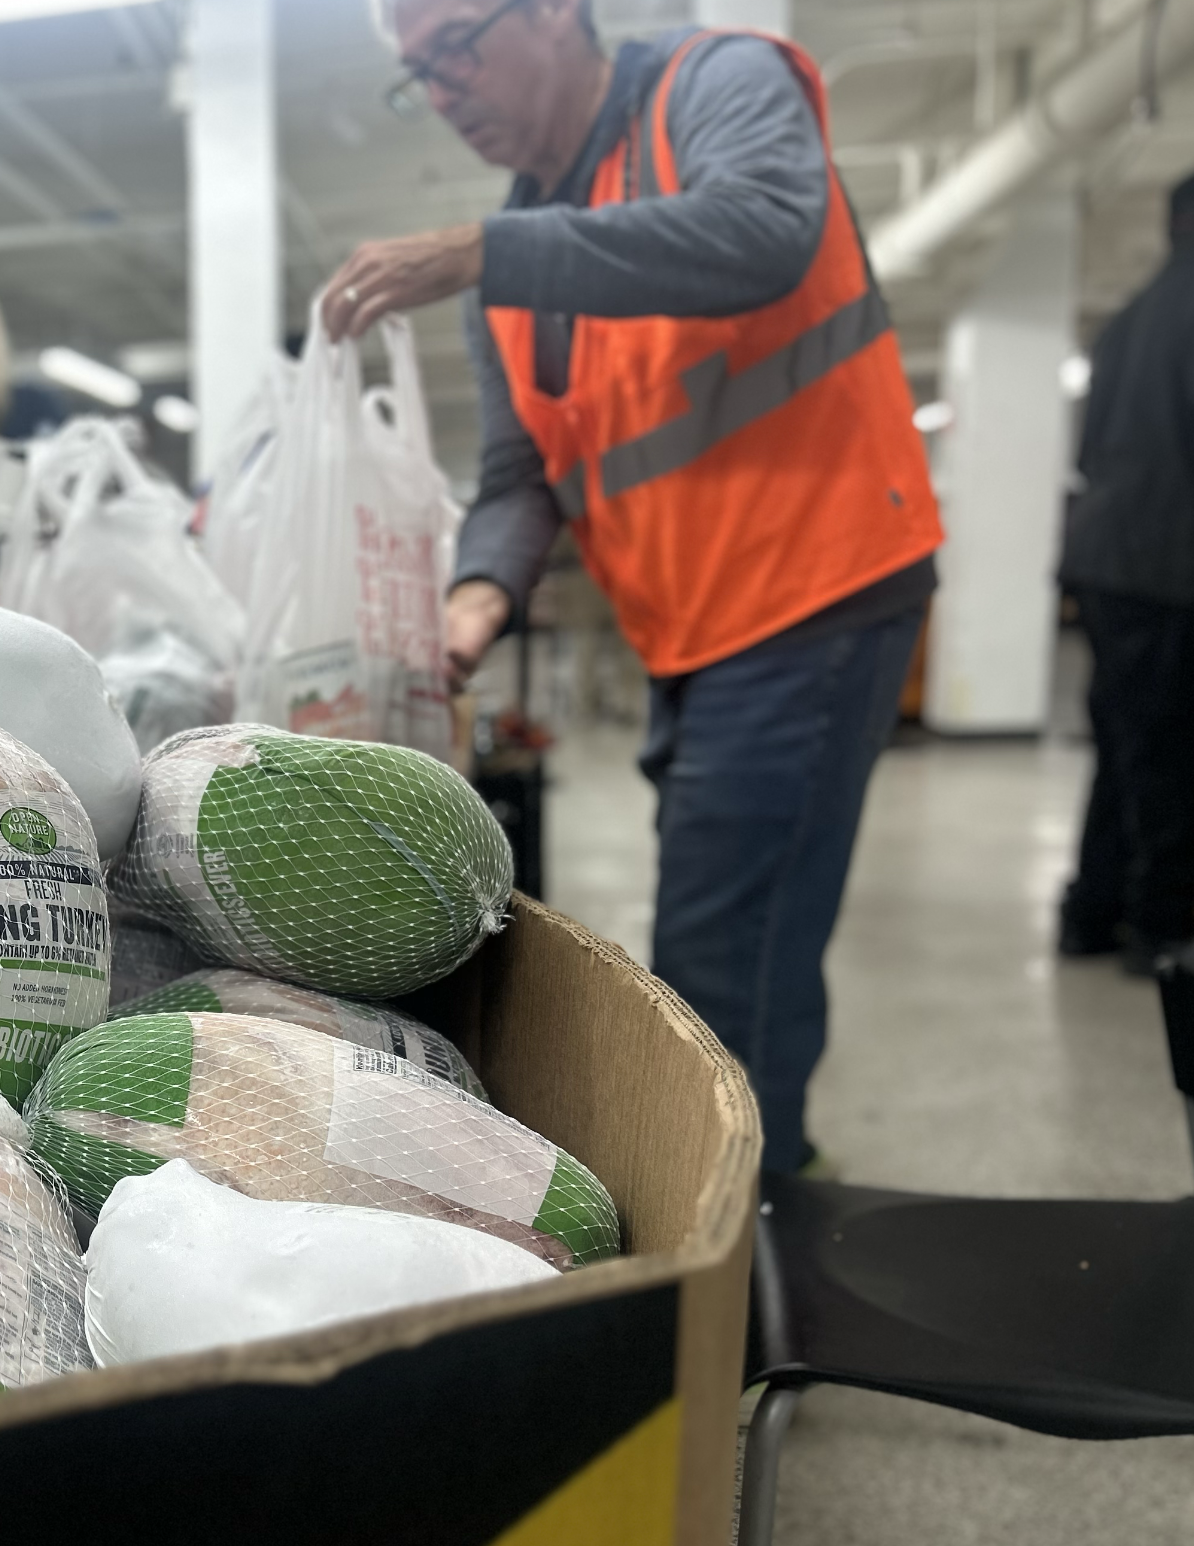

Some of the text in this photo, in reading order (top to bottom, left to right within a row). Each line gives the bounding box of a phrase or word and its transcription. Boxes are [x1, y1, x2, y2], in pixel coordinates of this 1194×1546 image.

[12, 812, 40, 824] OPEN
[10, 823, 49, 836] NATURE
[203, 850, 237, 895] EVER
[24, 880, 62, 900] FRESH
[29, 945, 39, 958] UP
[41, 946, 50, 959] TO
[22, 984, 39, 992] ADDED
